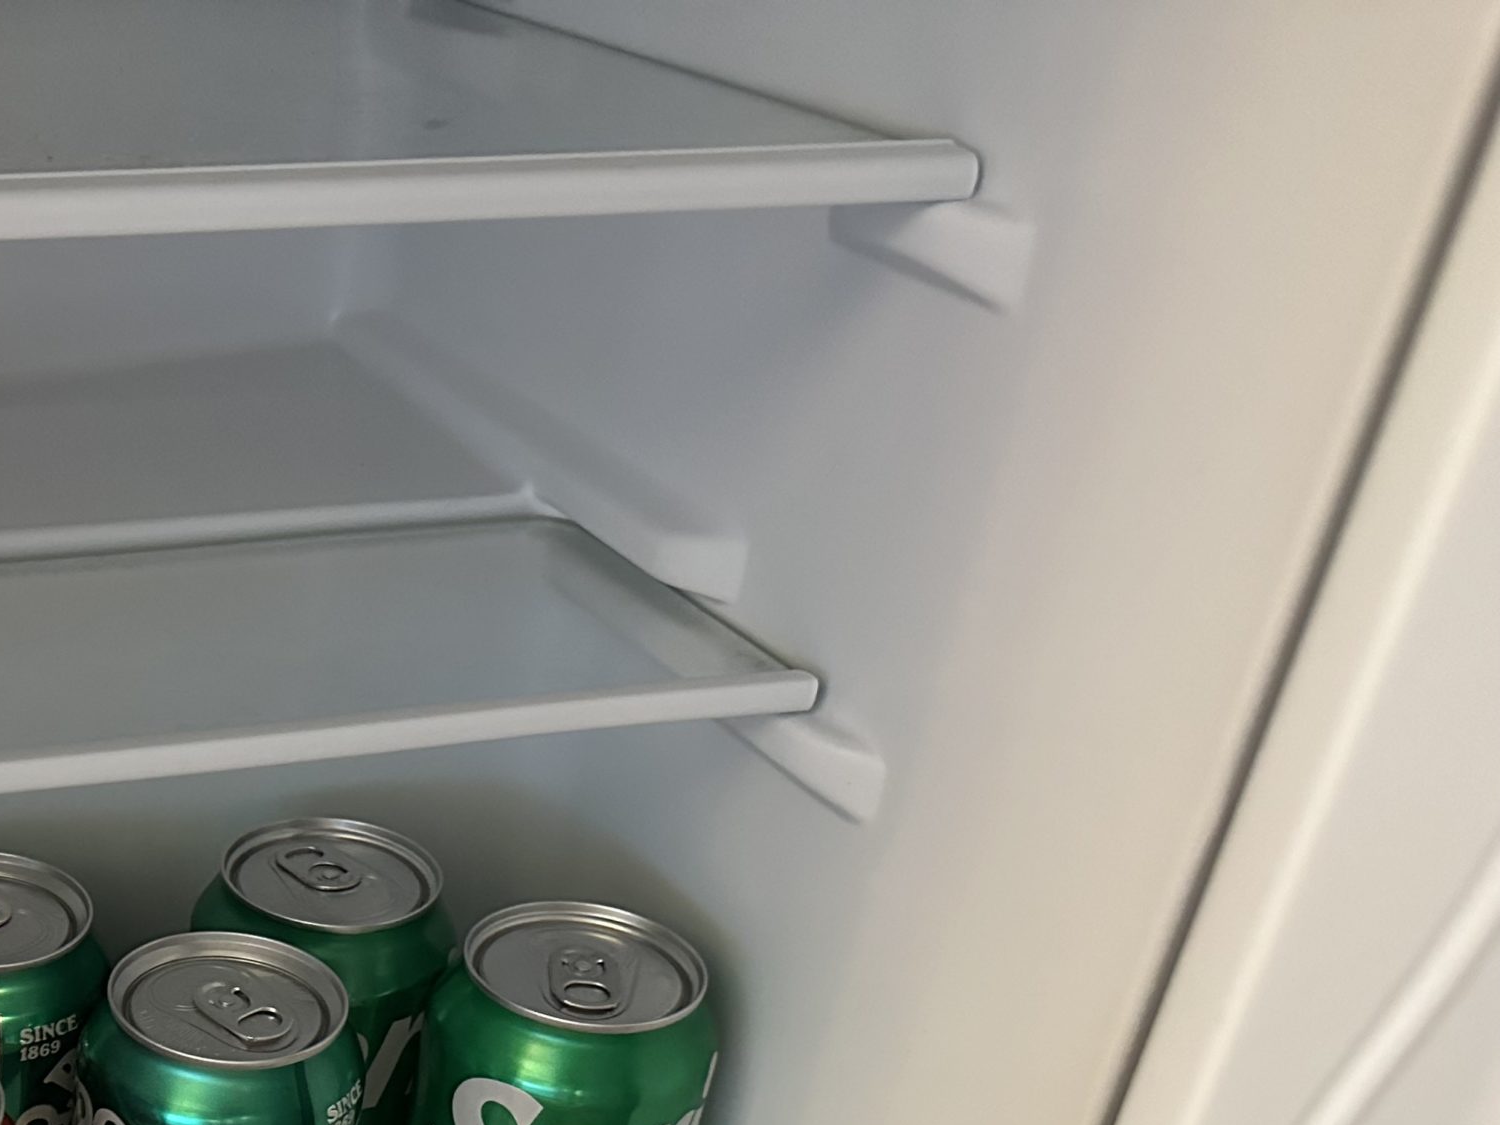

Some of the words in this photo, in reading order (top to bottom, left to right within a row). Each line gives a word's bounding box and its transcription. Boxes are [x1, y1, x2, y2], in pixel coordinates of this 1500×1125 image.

[19, 1014, 79, 1046] SINCE
[19, 1040, 61, 1062] 1869
[327, 1079, 363, 1124] SINCE
